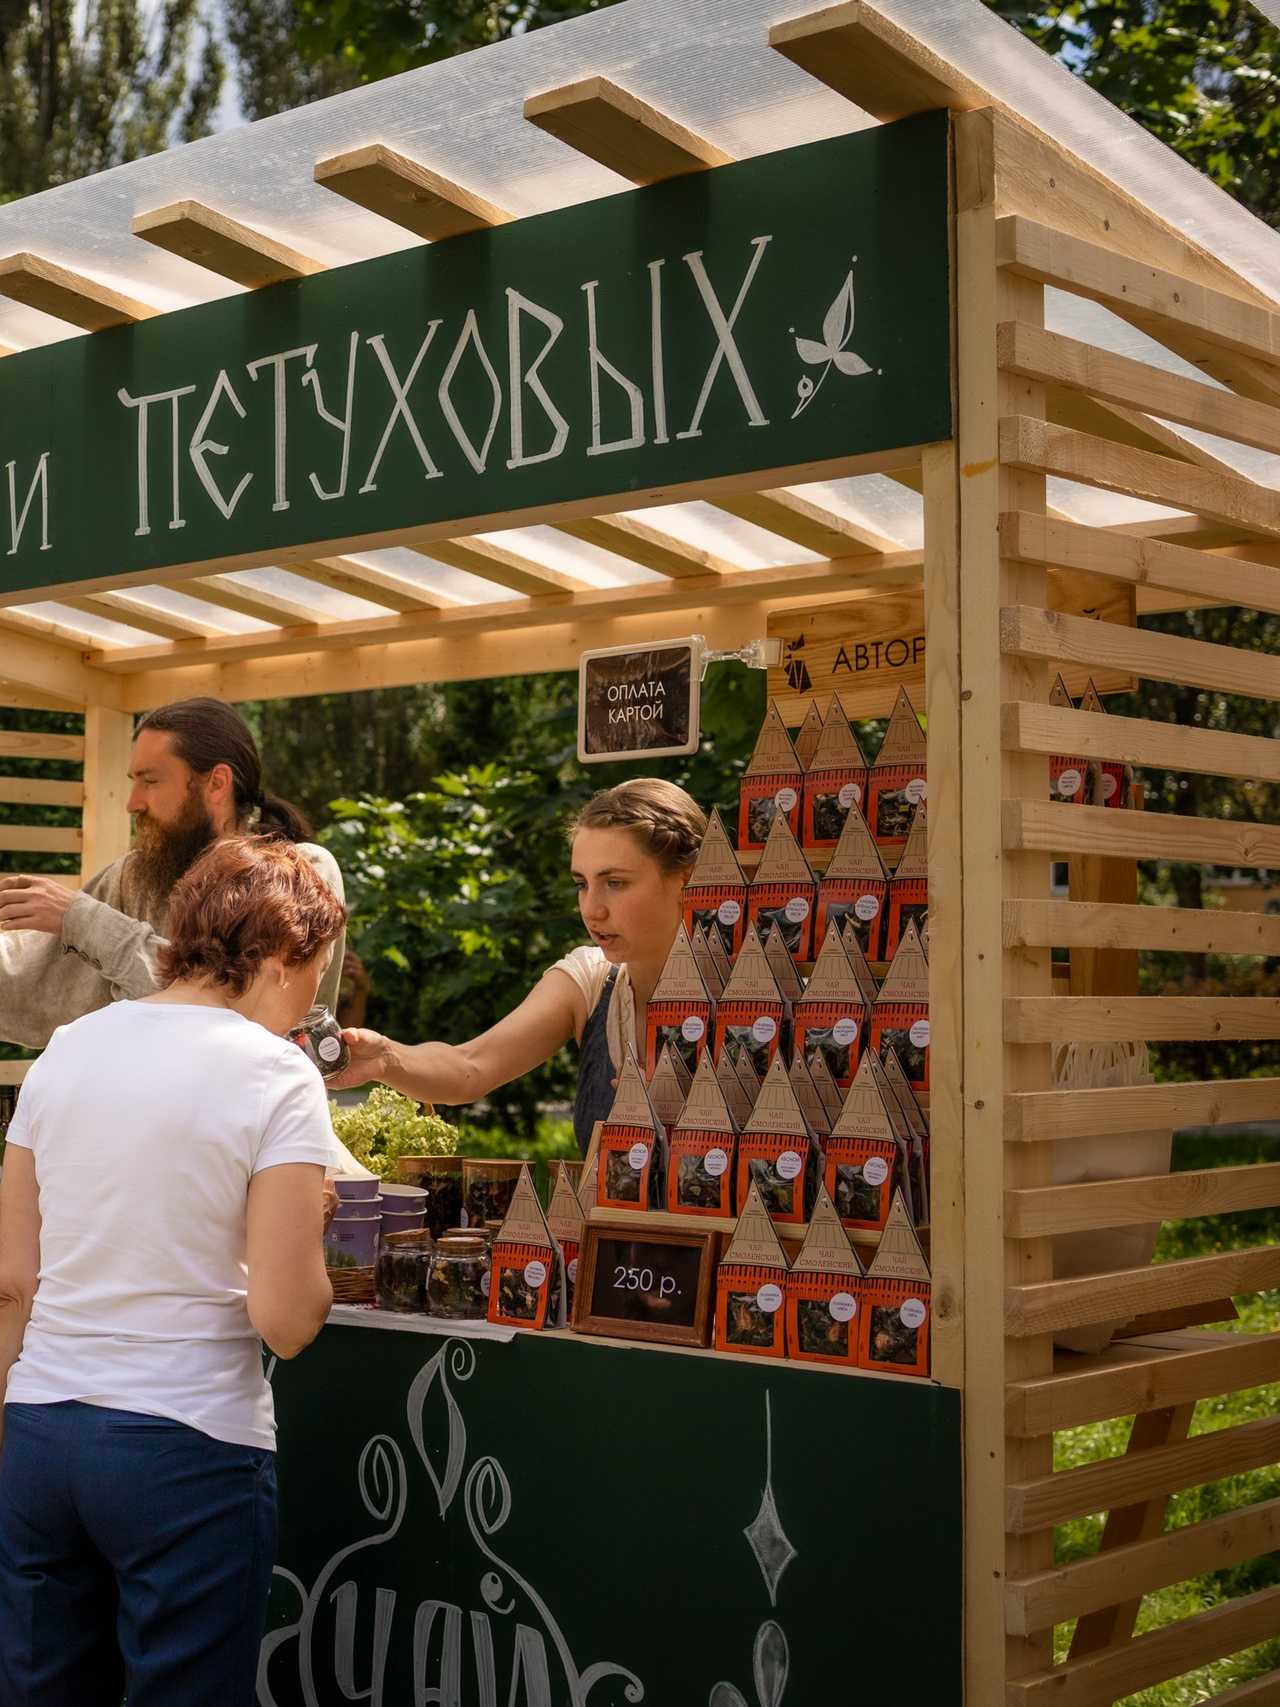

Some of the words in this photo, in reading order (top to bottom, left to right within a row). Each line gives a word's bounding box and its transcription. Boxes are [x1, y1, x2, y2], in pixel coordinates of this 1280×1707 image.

[117, 235, 773, 536] ПЕТУХОВЫХ
[607, 681, 666, 702] ОПЛАТА
[608, 701, 664, 724] КАРТОЙ
[849, 858, 863, 866] ЧАЙ
[918, 858, 928, 866] ЧА
[709, 866, 723, 874] ЧАЙ
[776, 863, 790, 871] ЧАЙ
[831, 866, 878, 875] СМОЛЕНСКИЙ
[693, 874, 738, 882] СМОЛЕНСКИЙ
[758, 871, 806, 880] СМОЛЕНСКИЙ
[673, 980, 687, 988] ЧАЙ
[744, 980, 759, 988] ЧАЙ
[825, 981, 840, 989] ЧАЙ
[657, 989, 702, 997] СМОЛЕНСКИЙ
[727, 988, 775, 997] СМОЛЕНСКИЙ
[807, 989, 856, 998] СМОЛЕНСКИЙ
[699, 1109, 713, 1117] ЧАЙ
[769, 1112, 784, 1120] ЧАЙ
[683, 1117, 727, 1126] СМОЛЕНСКИЙ
[856, 1116, 871, 1124] ЧАЙ
[751, 1120, 801, 1129] СМОЛЕНСКИЙ
[838, 1125, 888, 1135] СМОЛЕНСКИЙ
[502, 1231, 545, 1241] СМОЛЕНСКИЙ
[748, 1243, 763, 1251] ЧАЙ
[729, 1251, 780, 1262] СМОЛЕНСКИЙ
[819, 1250, 835, 1258] ЧАЙ
[799, 1259, 853, 1269] СМОЛЕНСКИЙ
[892, 1256, 907, 1264] ЧАЙ
[874, 1264, 924, 1275] СМОЛЕНСКИЙ
[613, 1266, 653, 1291] 250
[659, 1276, 682, 1298] р.
